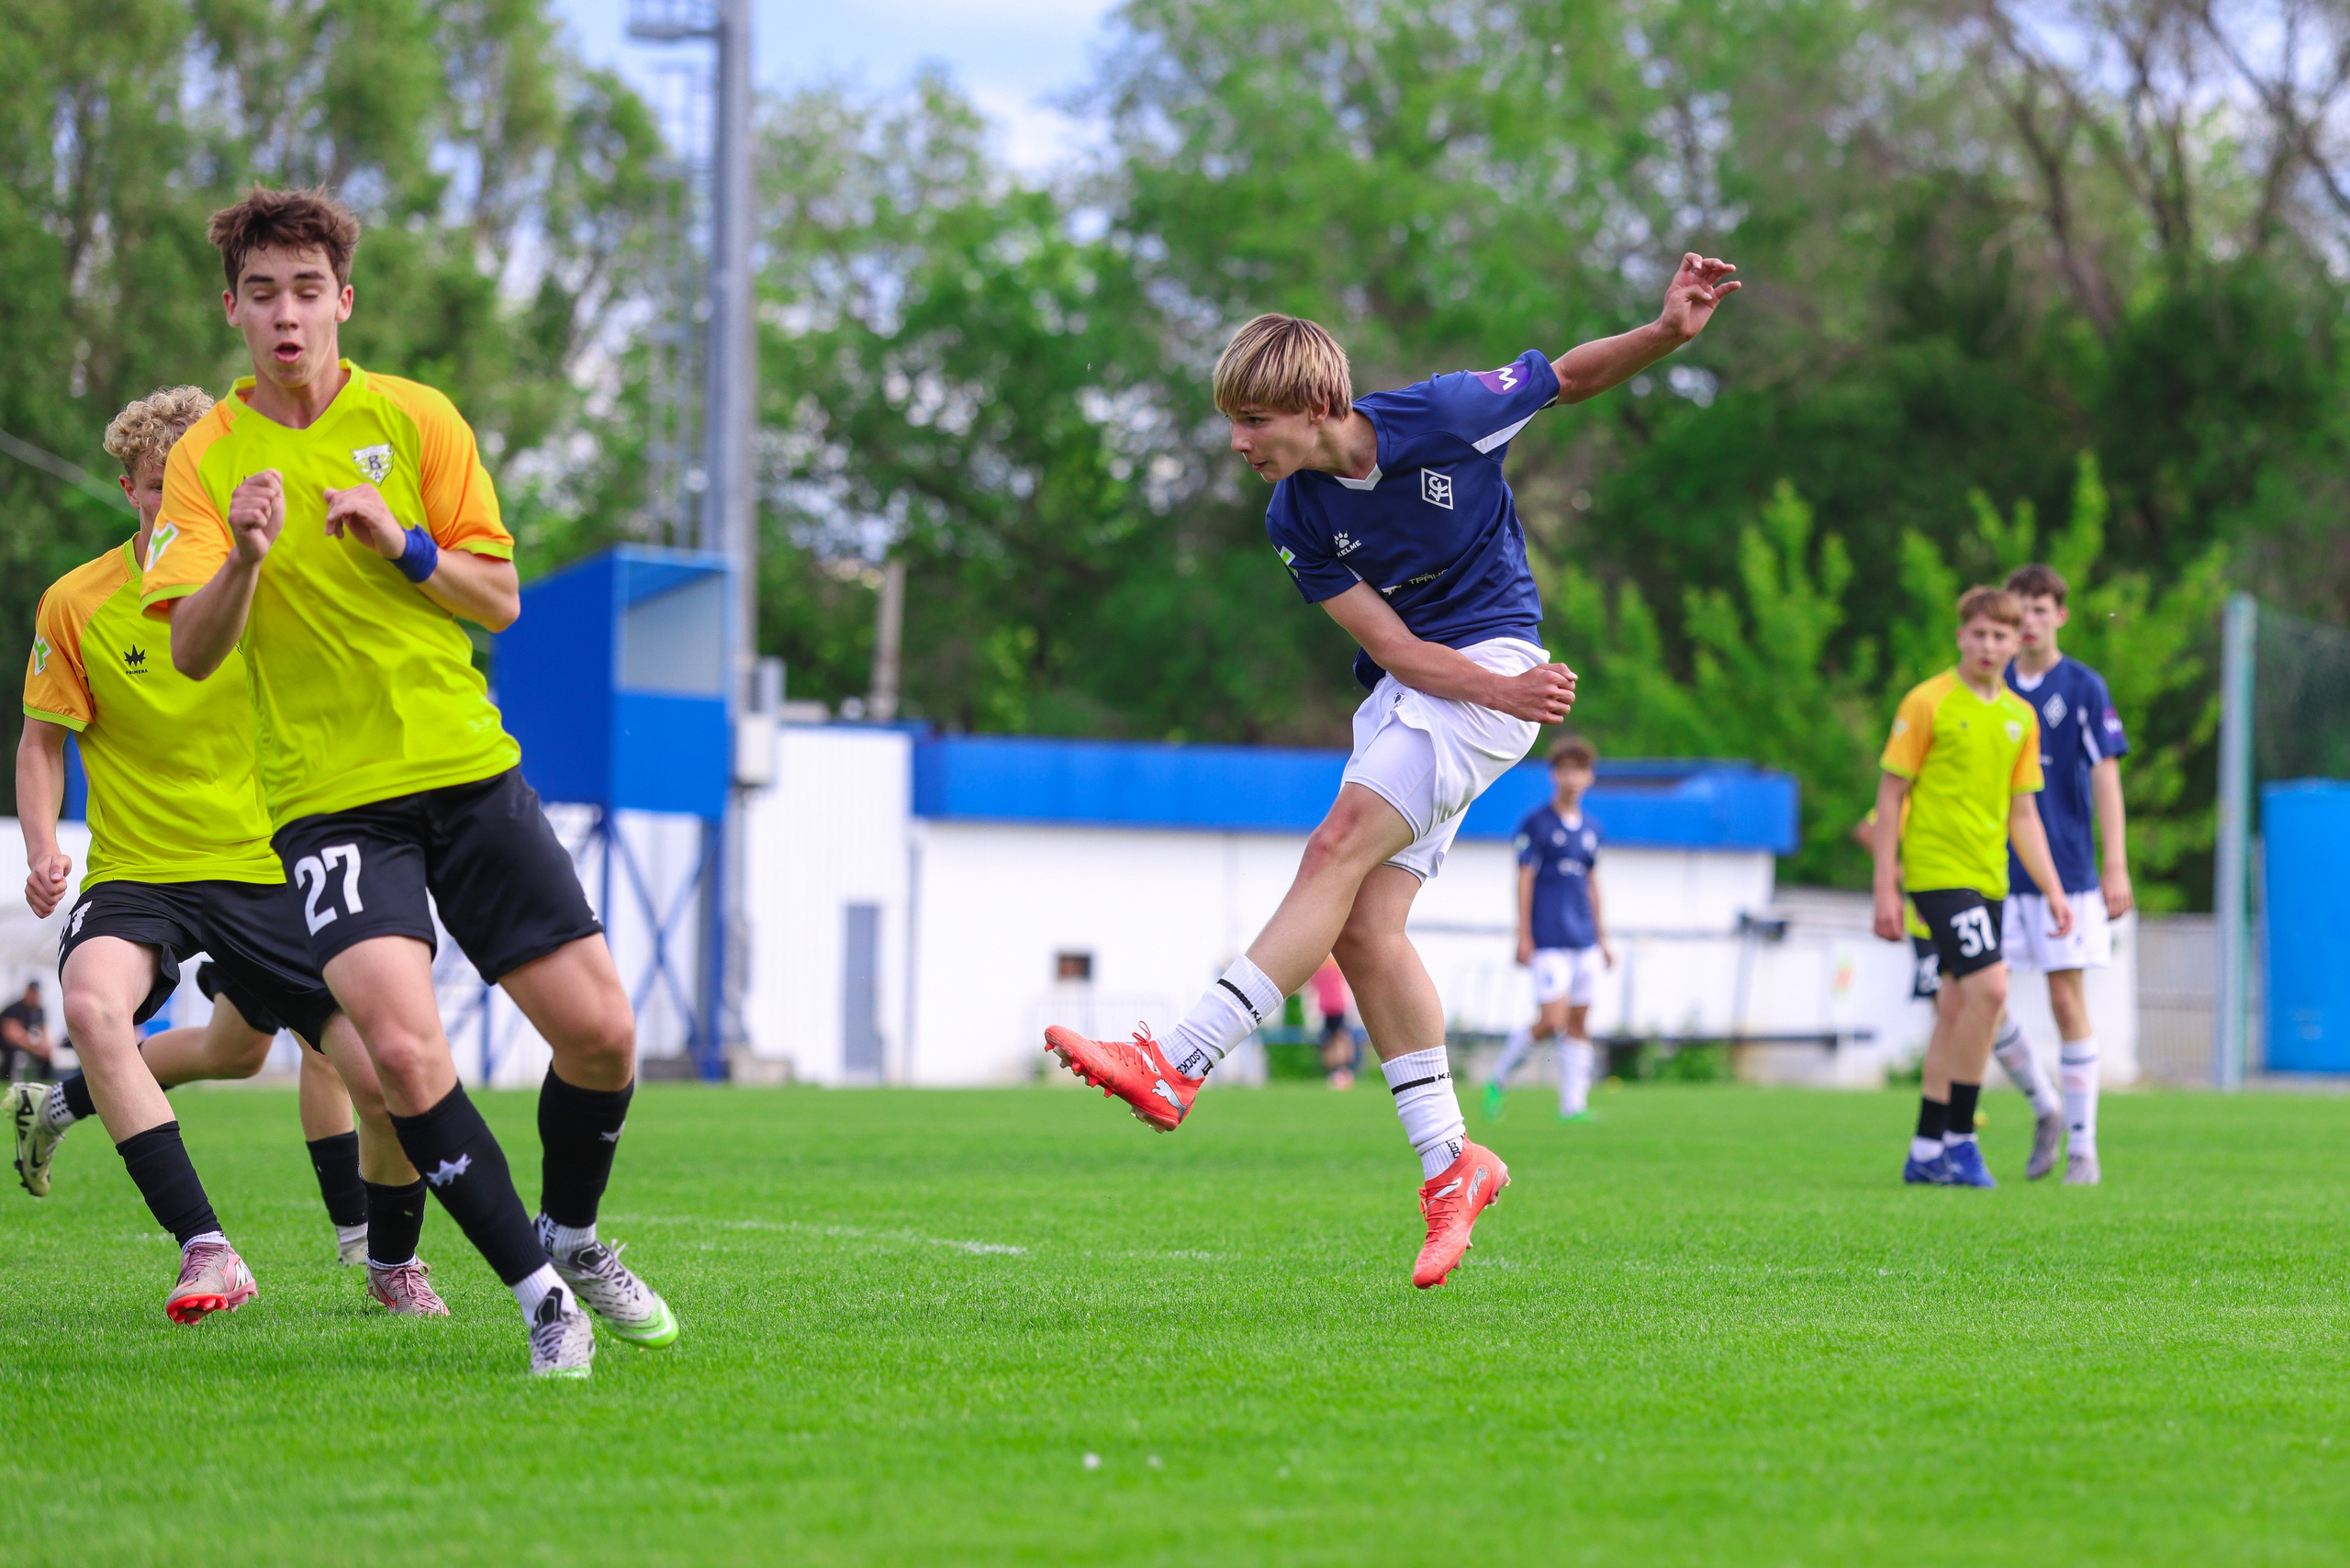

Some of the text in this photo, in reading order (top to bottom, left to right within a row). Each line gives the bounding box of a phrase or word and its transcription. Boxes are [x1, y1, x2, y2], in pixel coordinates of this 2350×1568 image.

[1337, 540, 1361, 558] KELME
[294, 842, 364, 937] 27
[1949, 905, 1998, 958] 37
